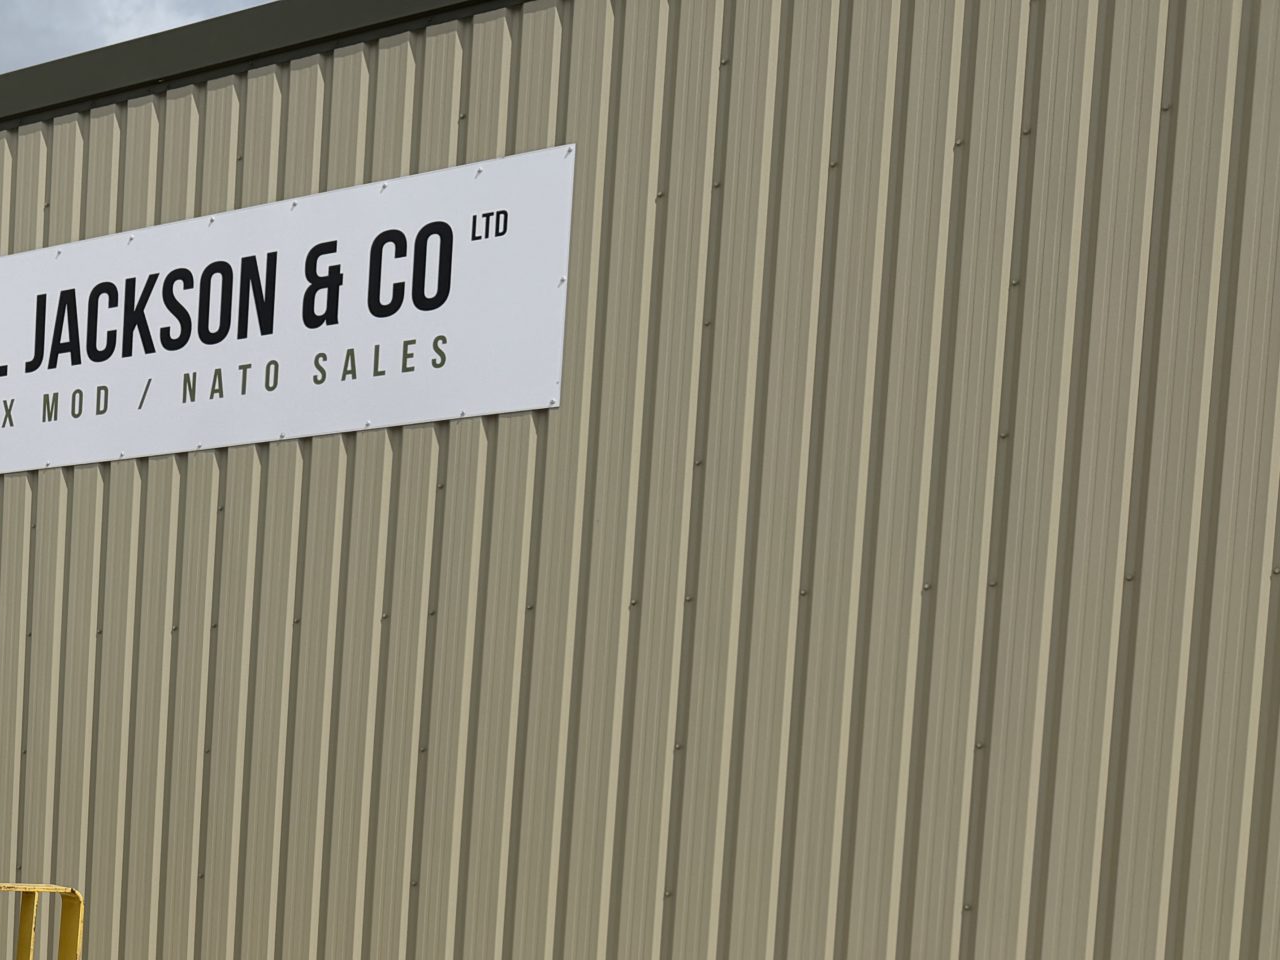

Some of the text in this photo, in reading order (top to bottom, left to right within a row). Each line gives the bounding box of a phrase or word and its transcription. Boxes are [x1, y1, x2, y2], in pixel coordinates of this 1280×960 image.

[25, 251, 278, 373] JACKSON
[302, 240, 344, 329] &
[368, 221, 454, 318] CO
[471, 210, 508, 241] LTD
[42, 386, 109, 422] MOD
[137, 379, 153, 409] /
[183, 360, 280, 403] NATO
[313, 335, 448, 385] SALES
